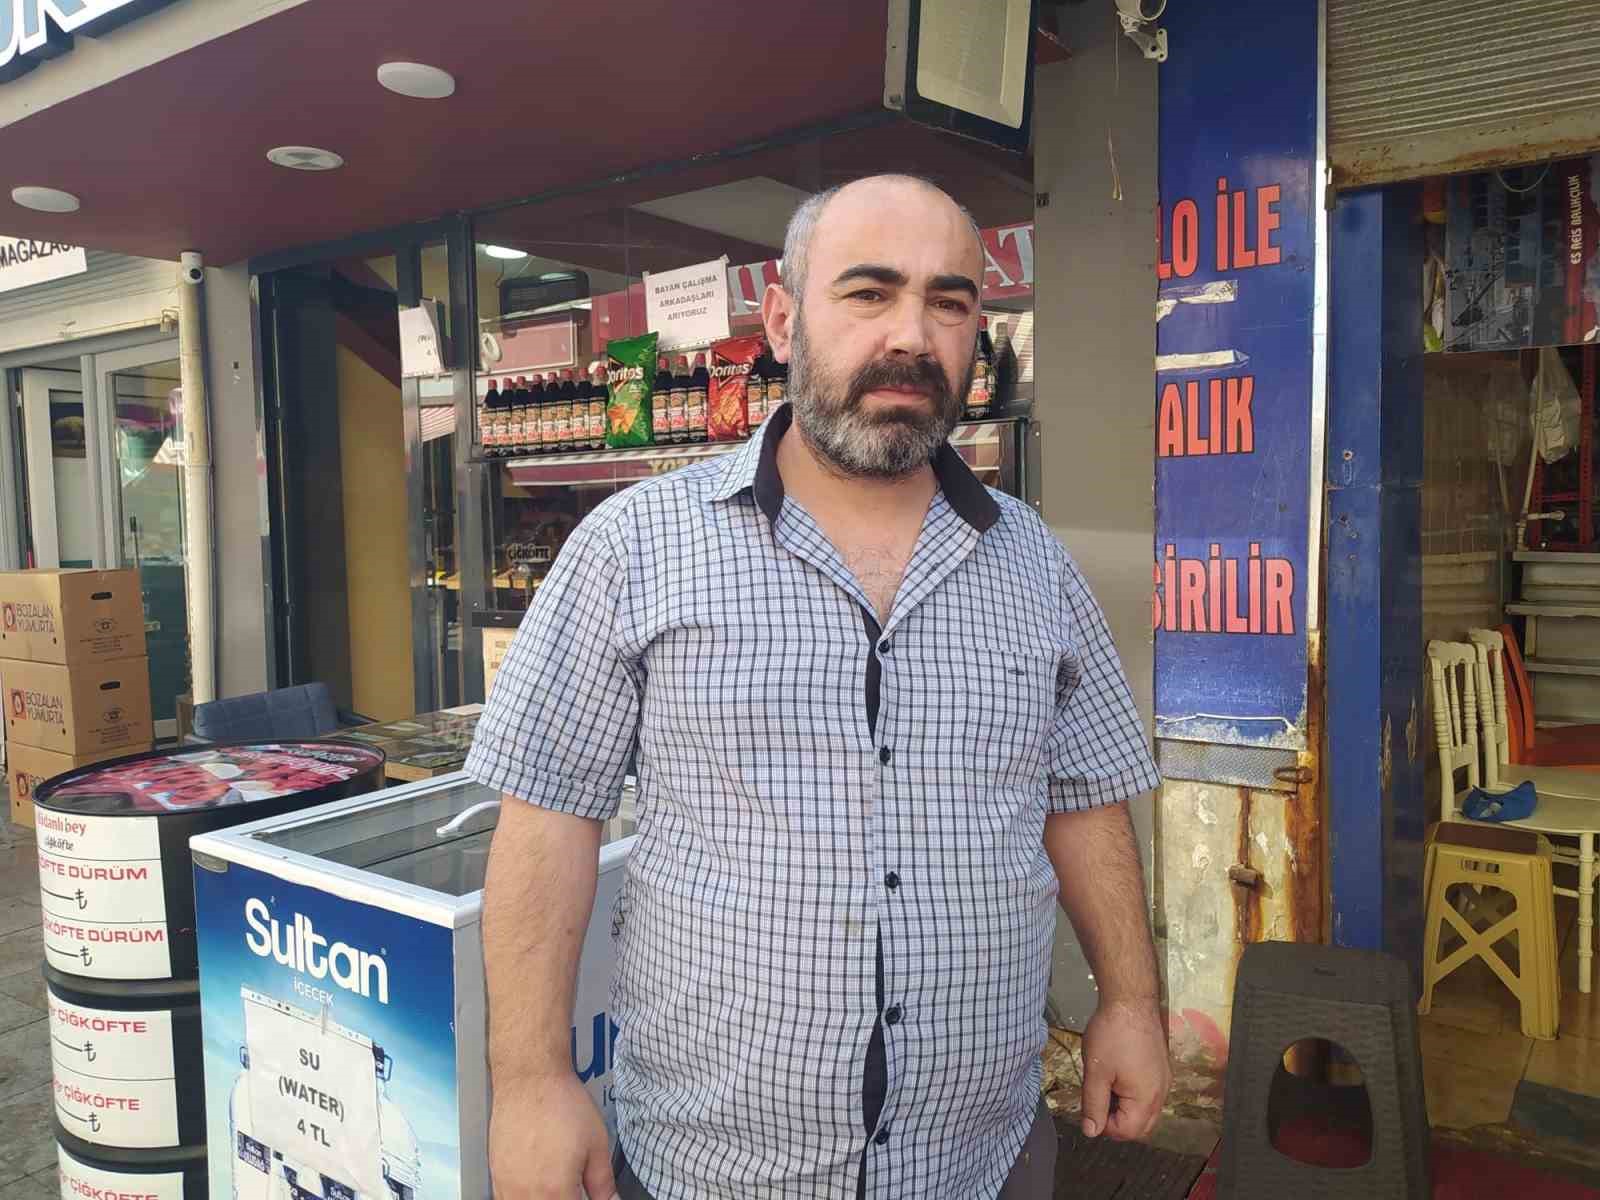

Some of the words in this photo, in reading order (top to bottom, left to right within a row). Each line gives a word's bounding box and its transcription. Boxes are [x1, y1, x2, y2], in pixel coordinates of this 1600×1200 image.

[1216, 176, 1281, 271] İLE
[1570, 252, 1582, 265] ES
[65, 817, 86, 837] bey
[68, 864, 148, 881] DÜRÜM
[88, 927, 164, 943] DÜRÜM
[245, 897, 389, 1005] Sultan
[58, 1008, 148, 1033] ÇİĞKÖFTE
[299, 1048, 321, 1071] SU
[278, 1075, 345, 1123] (WATER)
[297, 1118, 306, 1135] 4
[310, 1123, 331, 1148] TL
